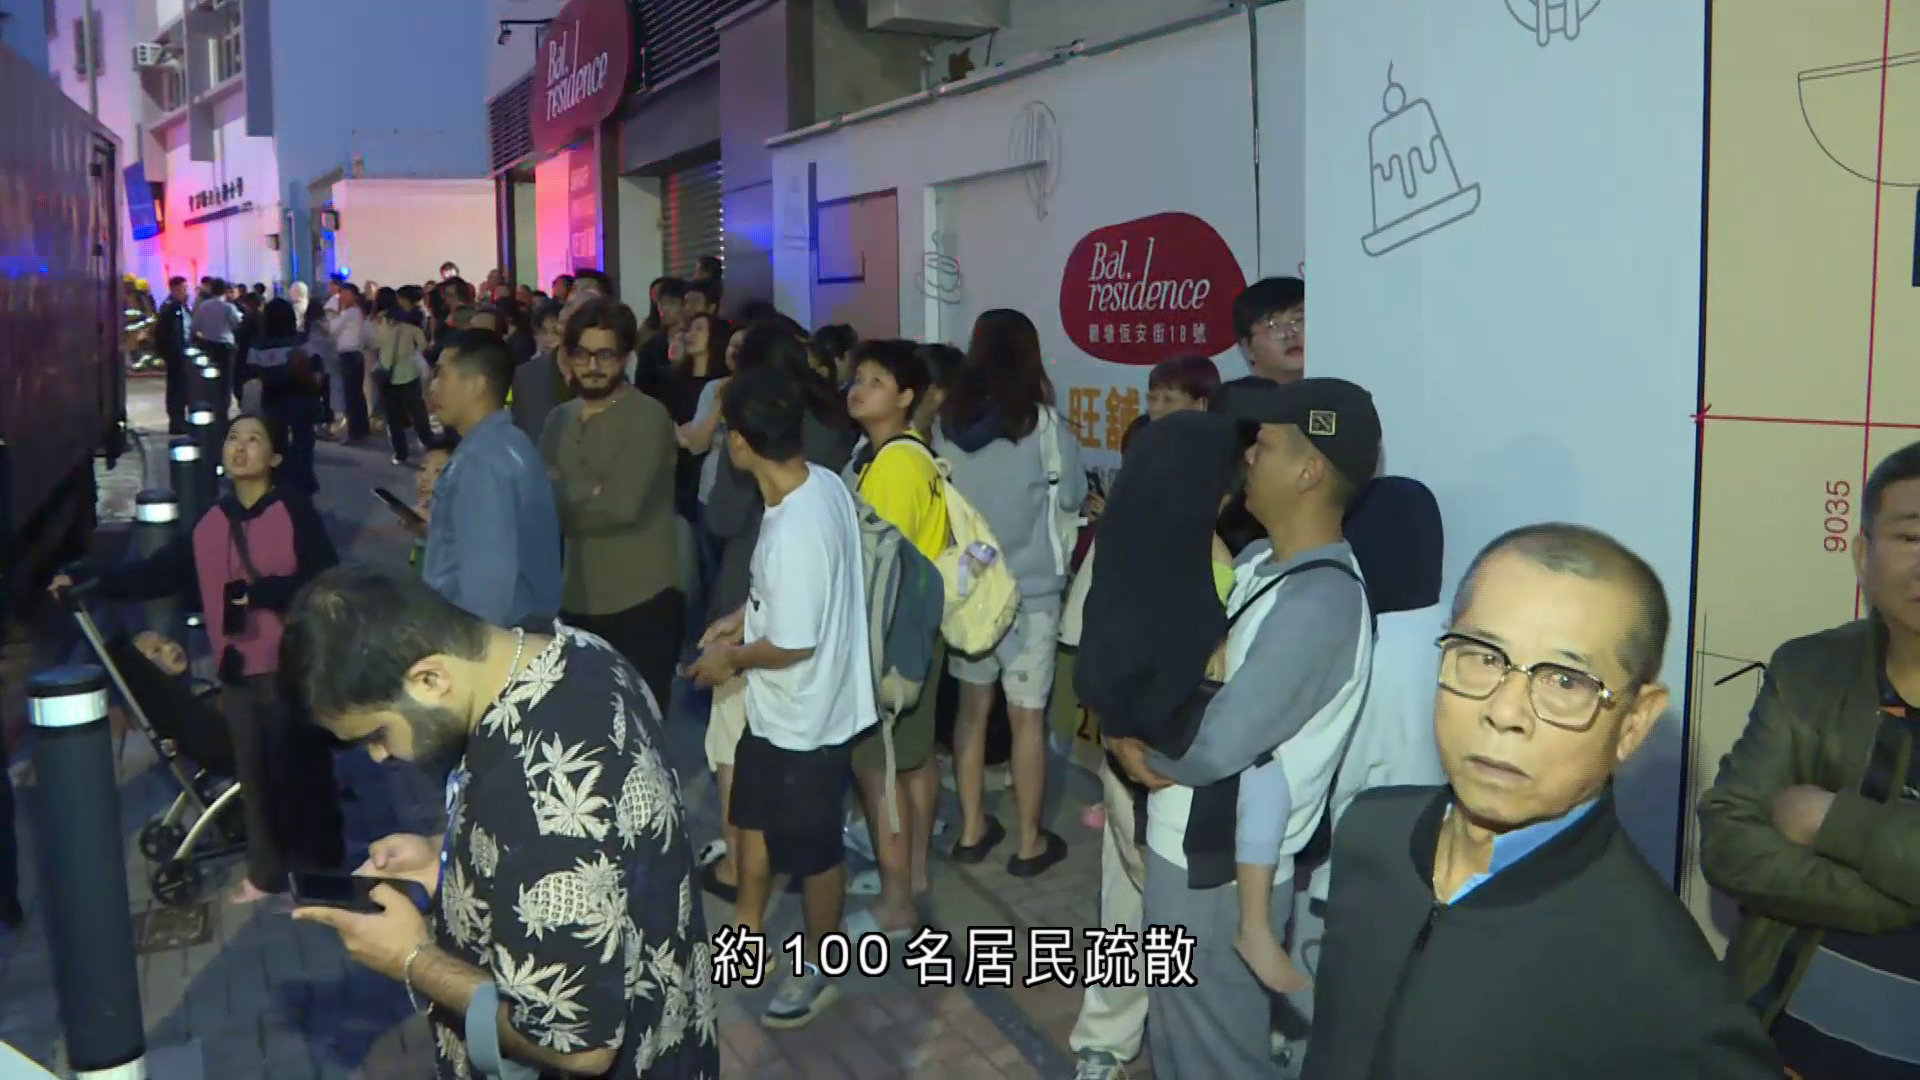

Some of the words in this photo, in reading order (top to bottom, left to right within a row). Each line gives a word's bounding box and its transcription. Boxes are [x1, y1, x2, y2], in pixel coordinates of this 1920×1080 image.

[545, 19, 608, 122] residence
[1088, 237, 1210, 312] residence
[1089, 240, 1132, 281] Bal.
[1824, 480, 1851, 553] 9035
